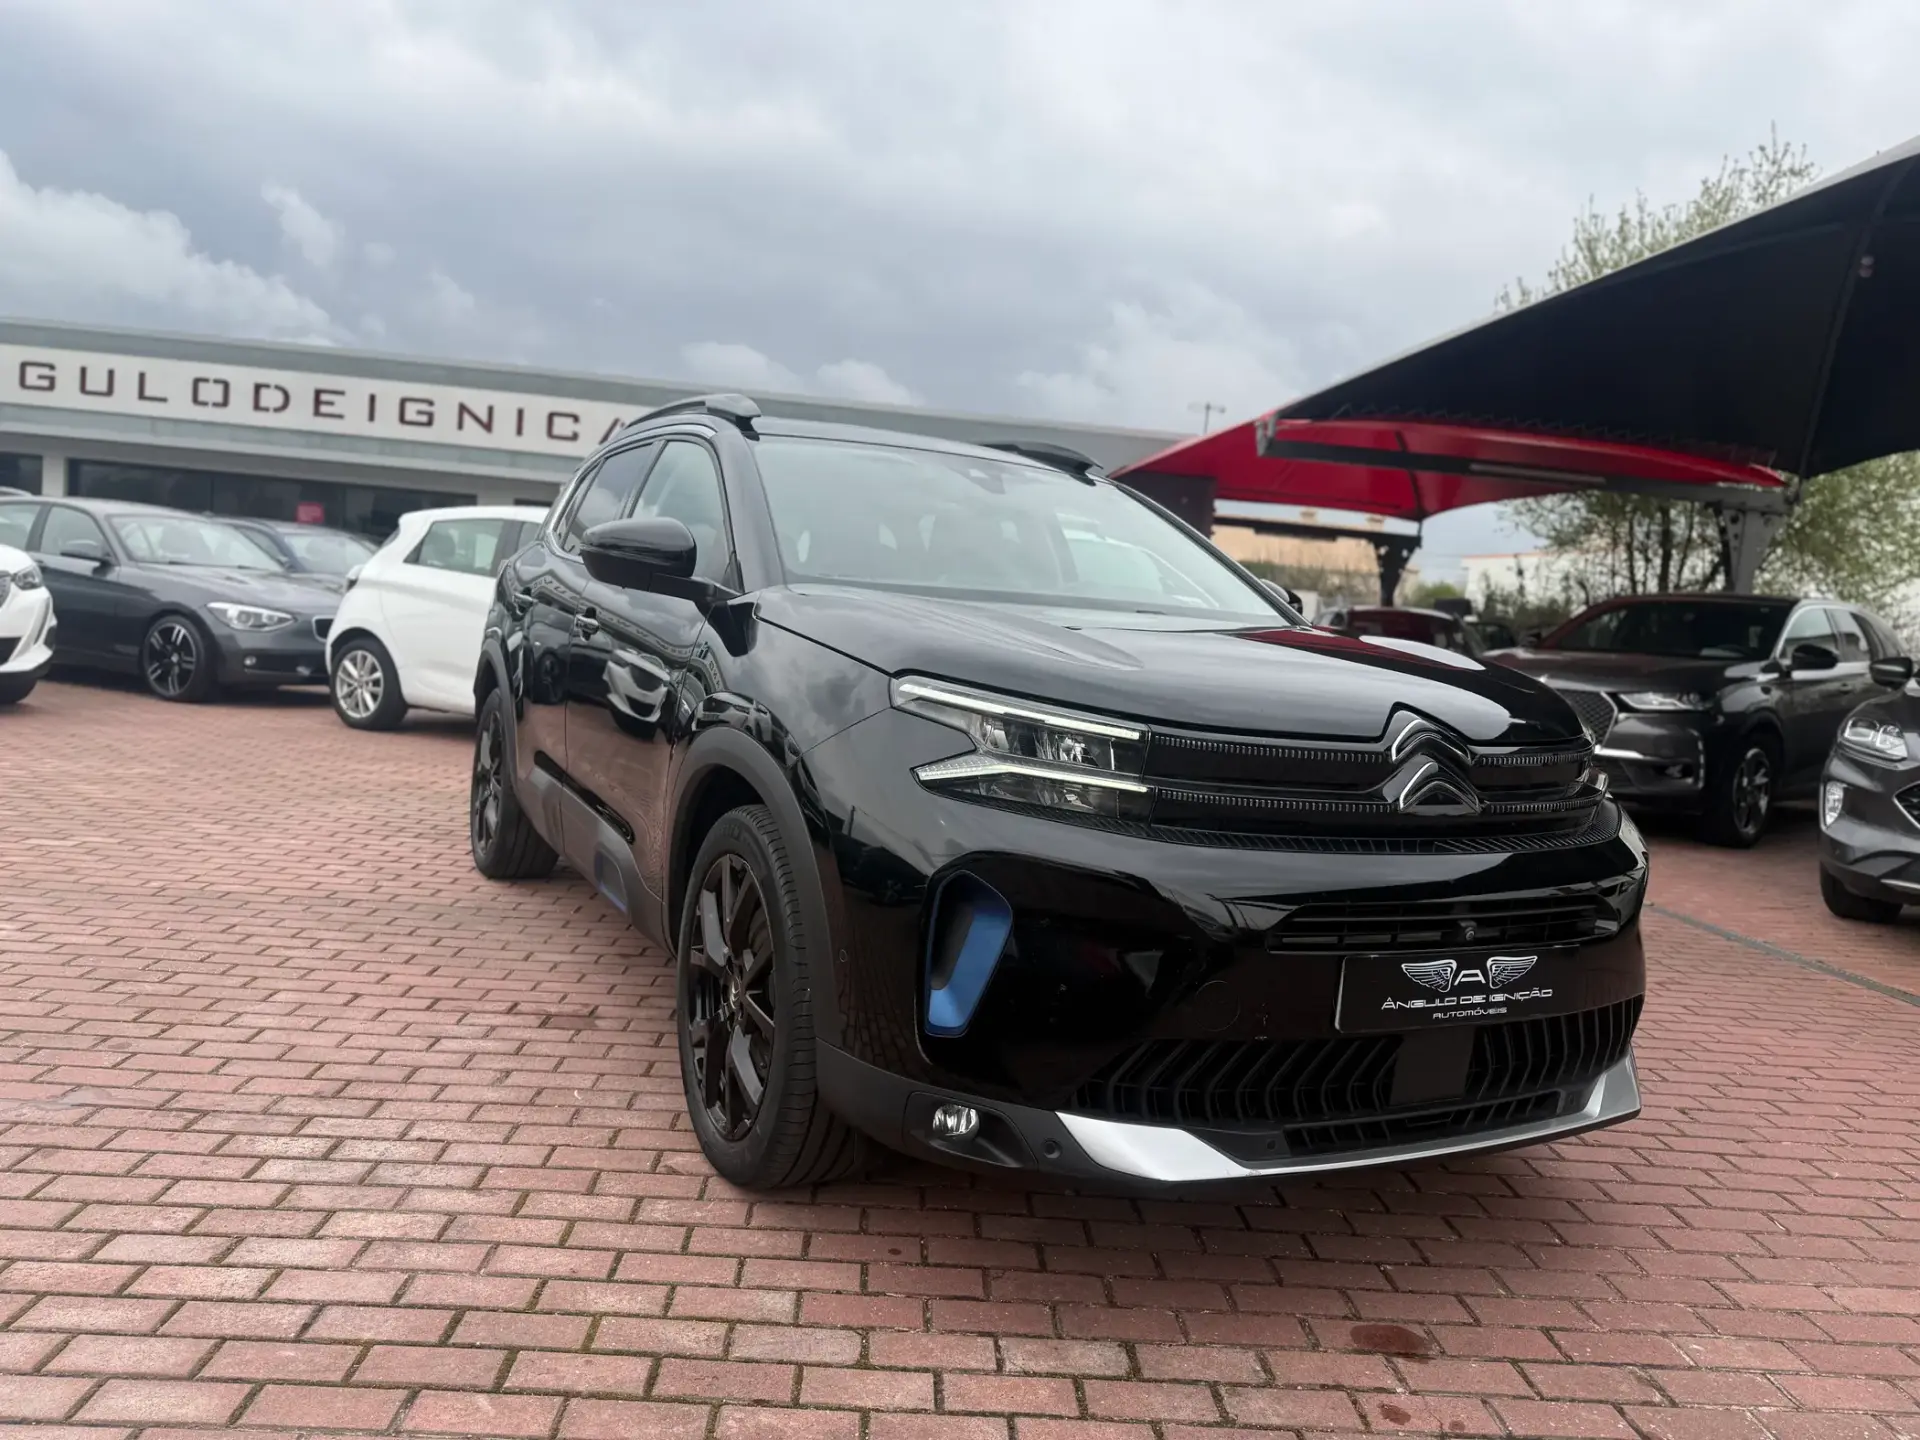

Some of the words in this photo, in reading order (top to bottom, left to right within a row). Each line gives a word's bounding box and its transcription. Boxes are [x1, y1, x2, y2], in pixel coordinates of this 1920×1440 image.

[1381, 996, 1457, 1010] ÂNGULO
[1459, 994, 1487, 1005] DE
[1489, 986, 1554, 1002] IGNIÇÃO
[1432, 1006, 1508, 1020] AUTOMÓVEIS
